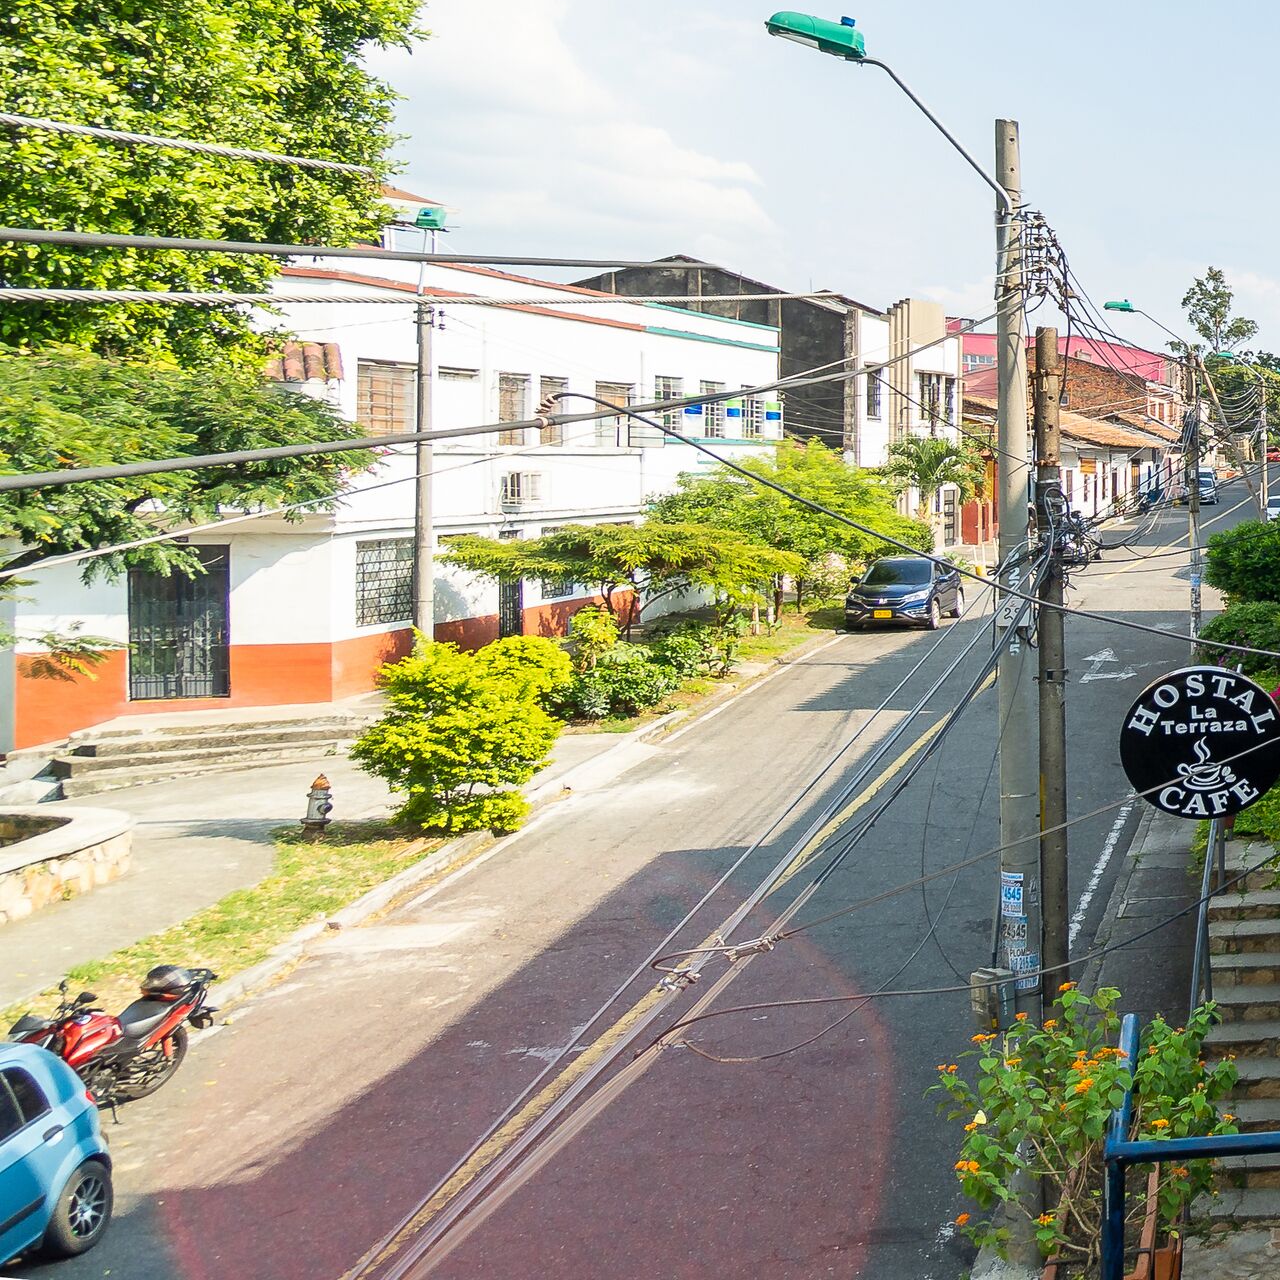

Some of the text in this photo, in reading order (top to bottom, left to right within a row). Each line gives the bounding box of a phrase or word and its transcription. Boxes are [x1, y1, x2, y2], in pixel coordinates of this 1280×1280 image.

[1128, 674, 1276, 736] HOSTAL
[1191, 705, 1217, 719] La
[1160, 719, 1248, 735] Terraza
[1158, 778, 1259, 815] CAFE
